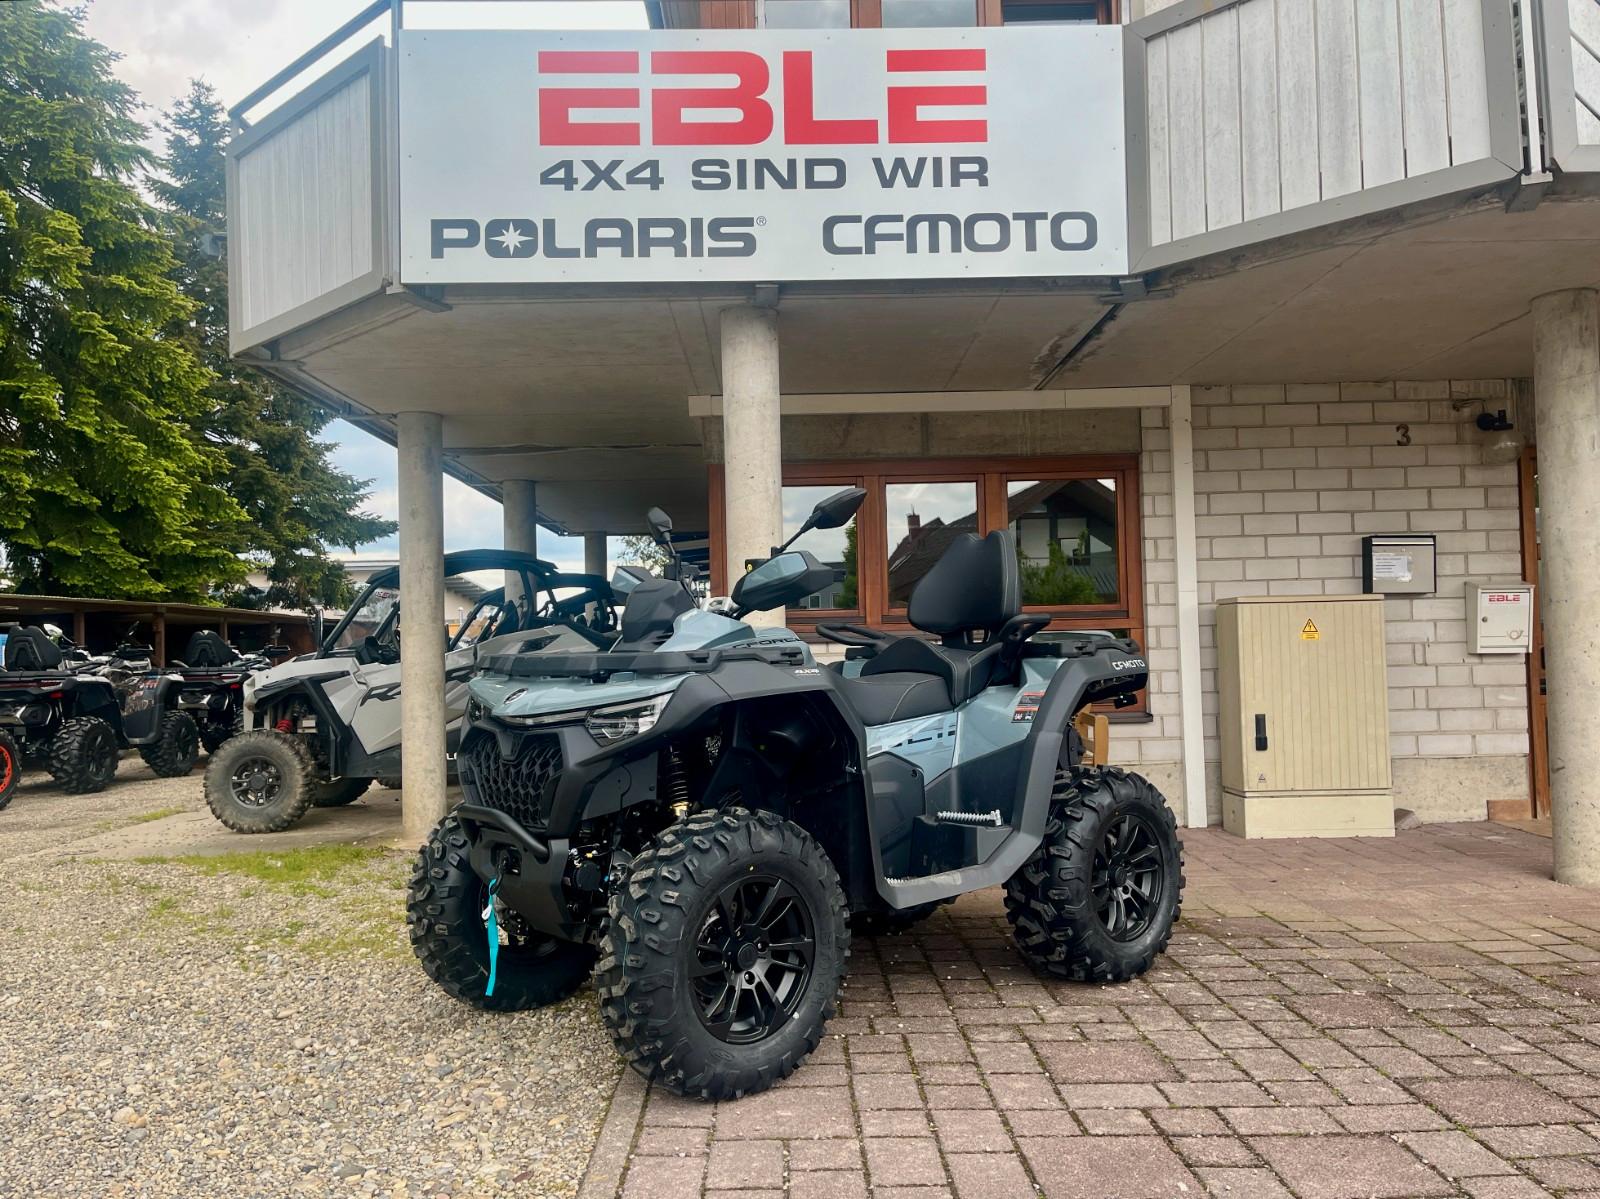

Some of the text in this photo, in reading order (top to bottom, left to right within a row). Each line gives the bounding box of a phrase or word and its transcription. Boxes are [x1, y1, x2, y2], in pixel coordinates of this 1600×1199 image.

[539, 49, 988, 146] EBLE
[540, 156, 989, 192] 4X4 SIND WIR
[822, 211, 1098, 256] CFMOTO
[1396, 424, 1412, 447] 3
[1488, 594, 1521, 602] EBLE
[1111, 659, 1146, 671] CFMOTO
